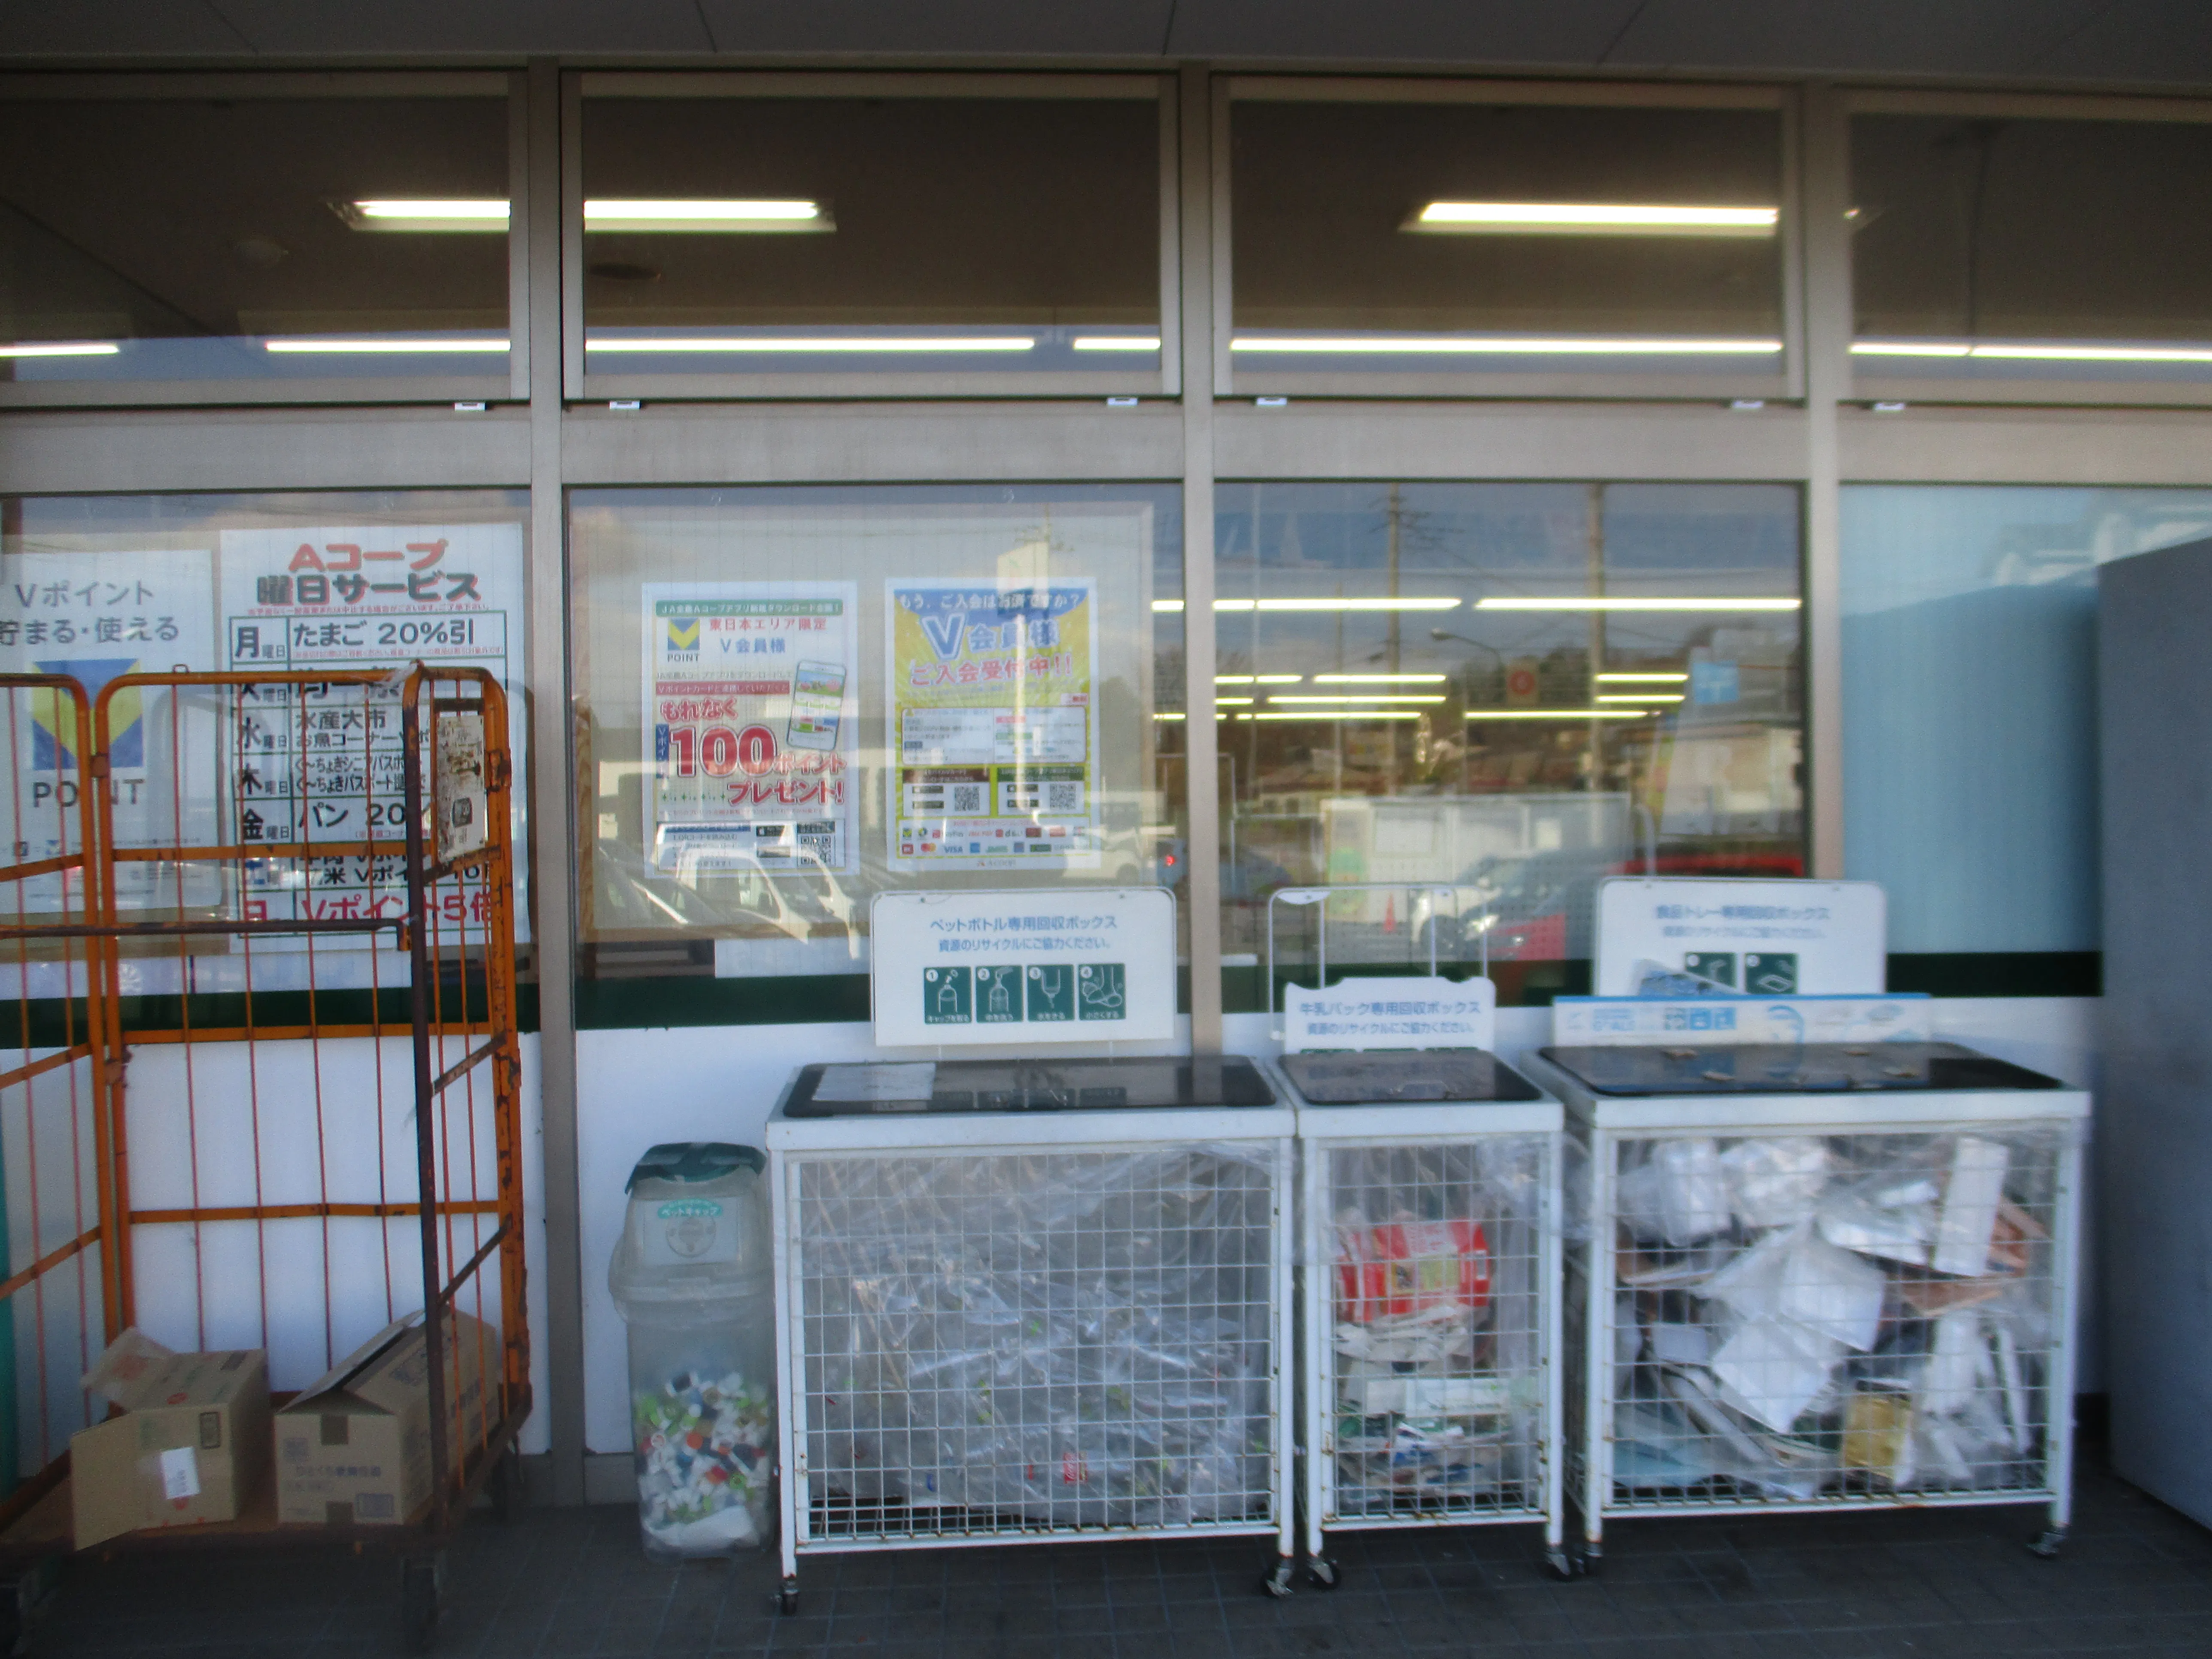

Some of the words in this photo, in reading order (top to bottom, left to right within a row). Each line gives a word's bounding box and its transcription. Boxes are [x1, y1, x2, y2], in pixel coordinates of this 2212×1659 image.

[289, 538, 449, 572] Aコープ
[14, 580, 154, 608] Vポイント
[257, 570, 483, 606] 曜日サービス
[293, 620, 368, 647] たまご
[378, 618, 474, 645] 20%引
[709, 617, 827, 632] 東日本エリア限定
[235, 626, 286, 658] 月曜日
[668, 653, 699, 662] POINT
[660, 698, 738, 720] もれなく
[239, 716, 288, 749] 水曜日
[671, 725, 777, 777] 100
[33, 779, 145, 807] POT
[242, 763, 289, 795] 木曜日
[727, 779, 845, 805] プレゼント!
[243, 807, 290, 840] 金曜日
[299, 801, 349, 828] パン
[930, 916, 1117, 932] ペットボトル専用回収ボックス
